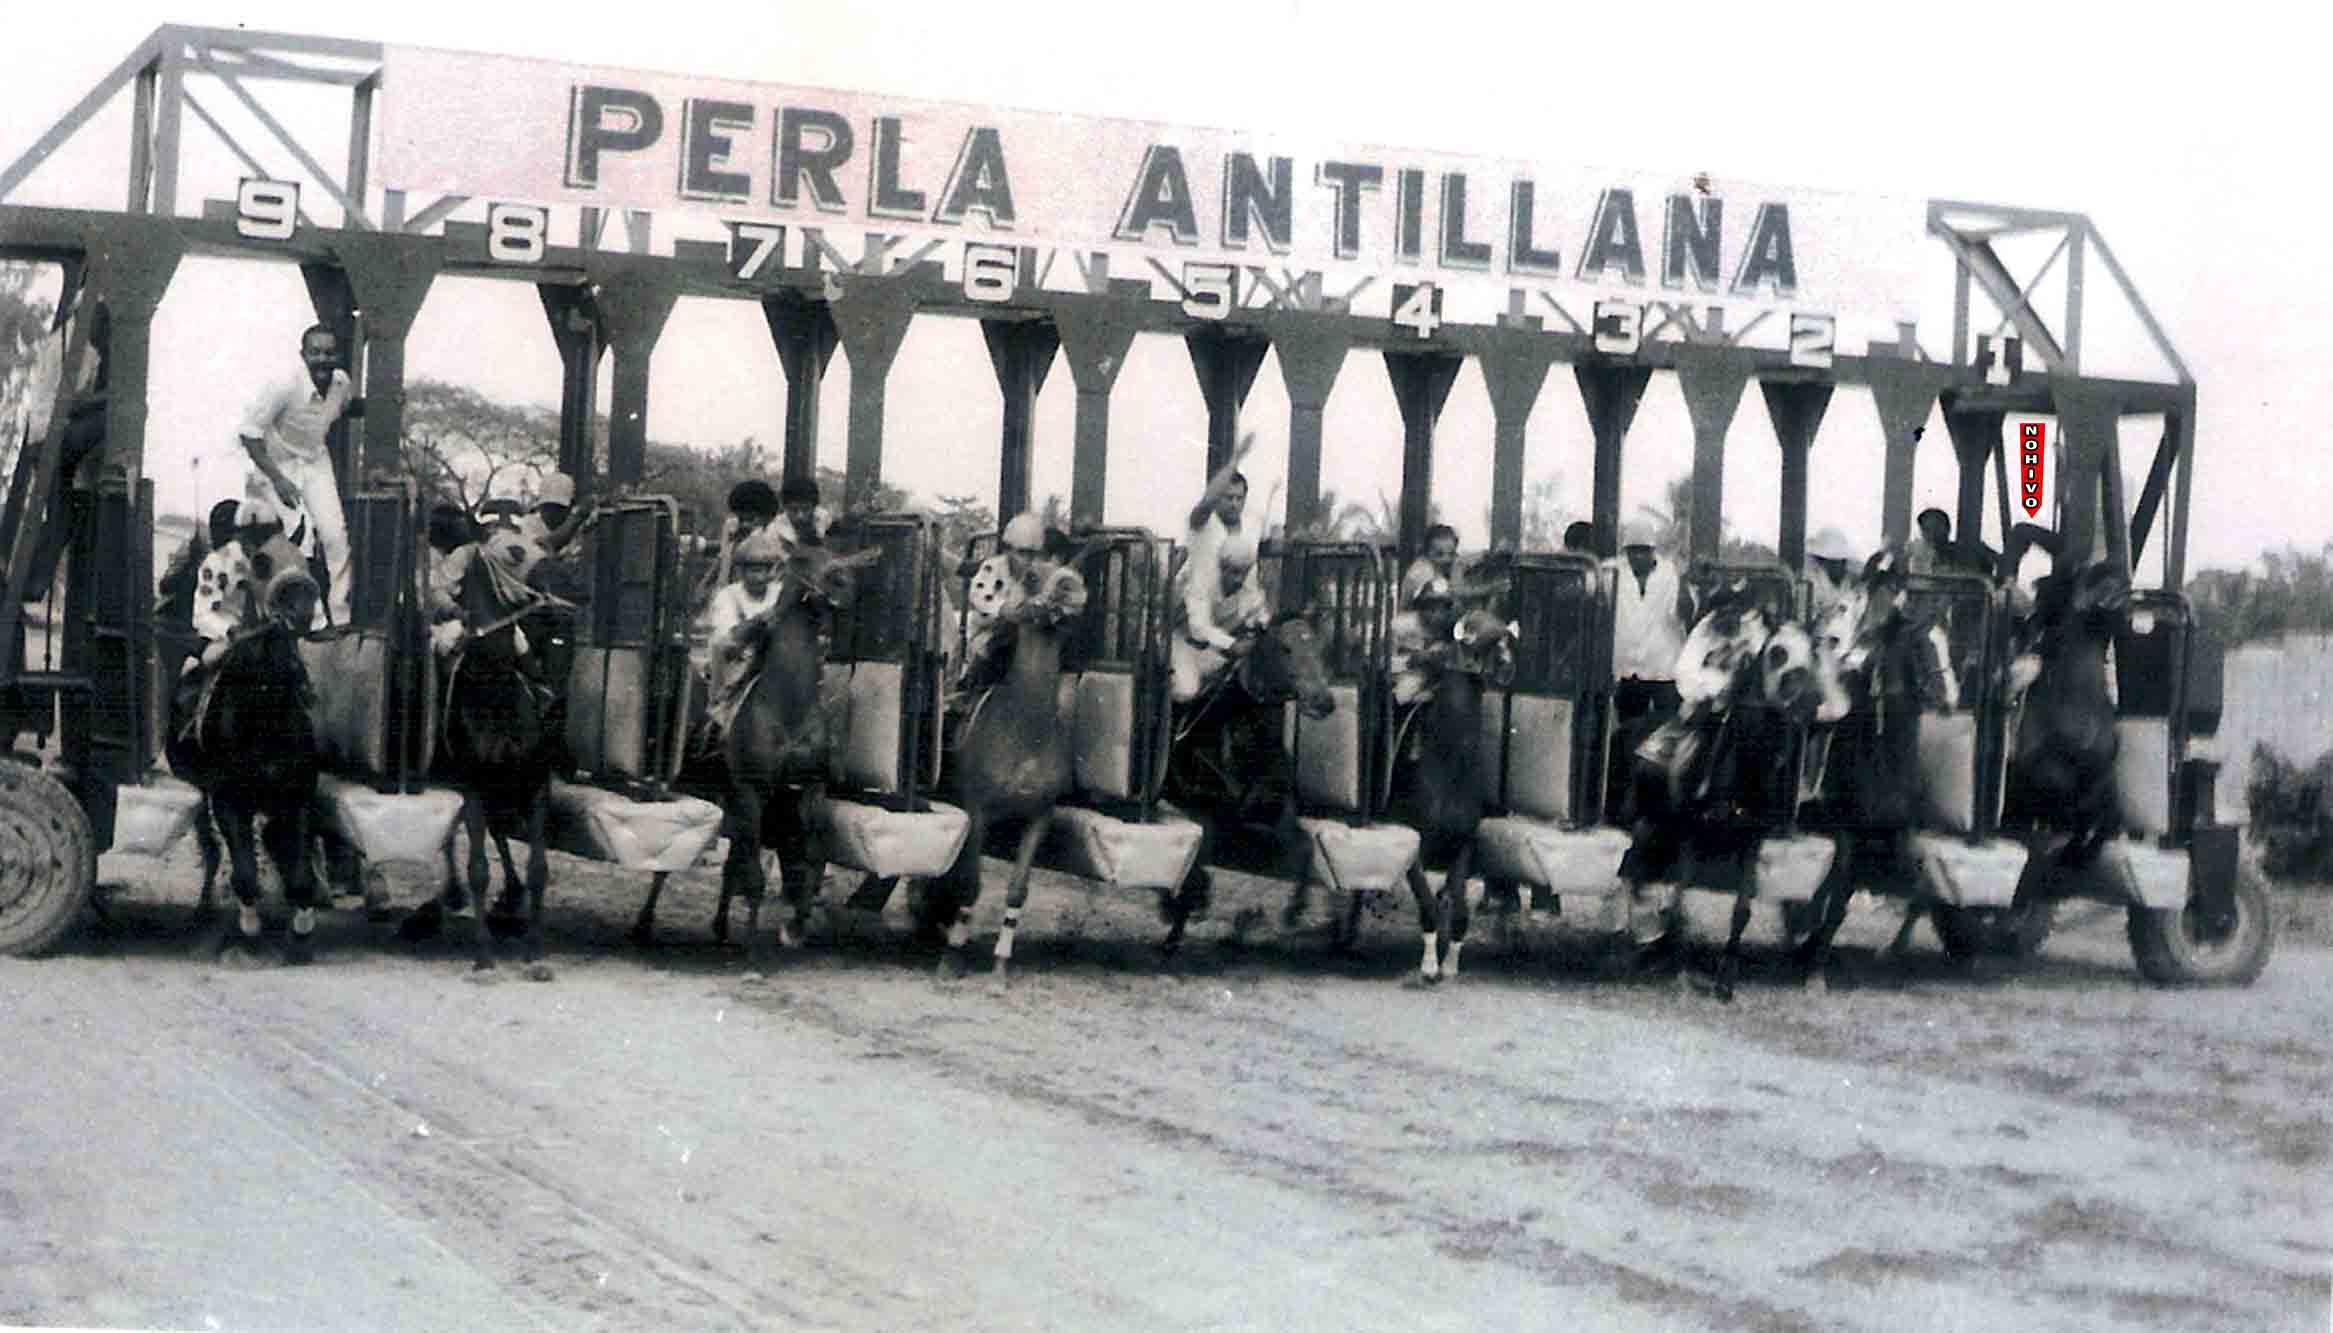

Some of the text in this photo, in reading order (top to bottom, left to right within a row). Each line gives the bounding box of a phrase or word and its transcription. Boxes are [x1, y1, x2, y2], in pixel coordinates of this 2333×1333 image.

[239, 179, 297, 240] 9
[564, 84, 1798, 297] PERLA ANTILLANA
[489, 206, 547, 263] 8
[730, 224, 783, 280] 7
[963, 245, 1015, 301] 6
[1182, 265, 1231, 321] 5
[1395, 282, 1440, 338] 4
[1594, 303, 1641, 354] 3
[1791, 316, 1834, 366] 2
[1986, 336, 2012, 386] 1
